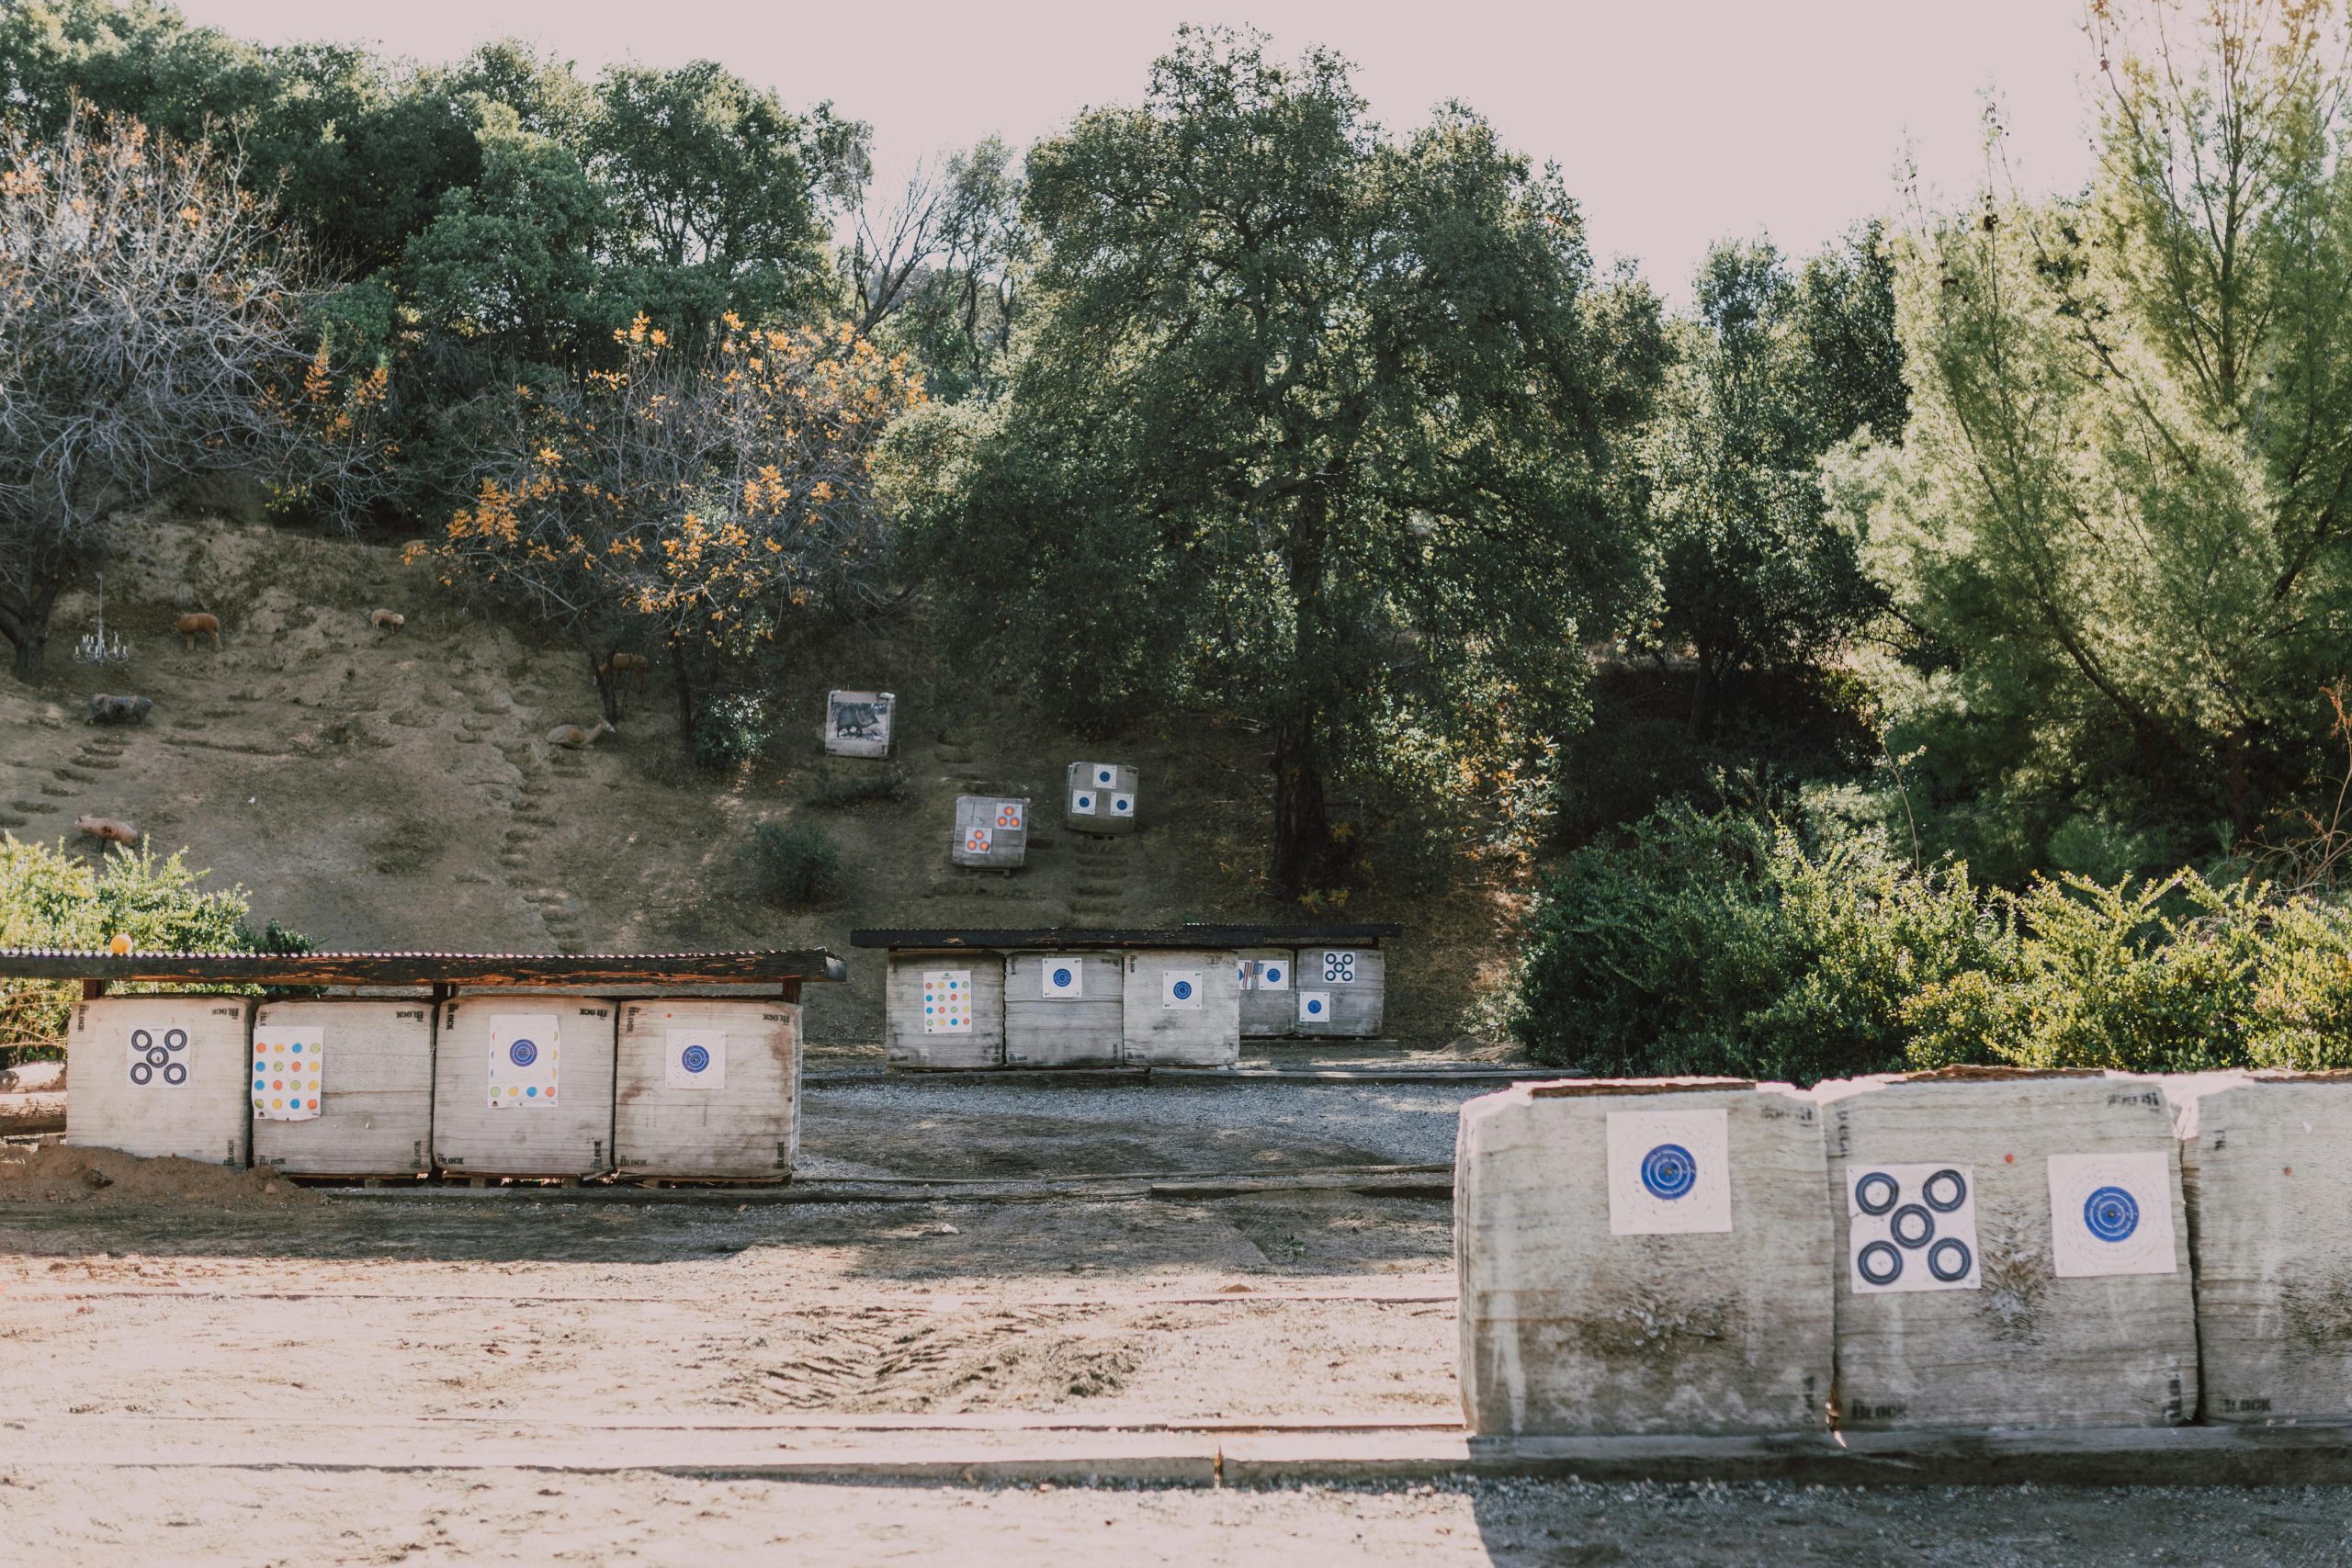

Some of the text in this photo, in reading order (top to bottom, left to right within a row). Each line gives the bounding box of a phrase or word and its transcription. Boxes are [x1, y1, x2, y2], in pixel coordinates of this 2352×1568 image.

[211, 1008, 239, 1017] BLOCK
[396, 1010, 424, 1019] BLOCK
[447, 1003, 457, 1030] BLOCK
[579, 1008, 607, 1017] BLOCK
[77, 1004, 87, 1032] BLOCK
[627, 1007, 637, 1032] BLOCK
[763, 1014, 790, 1023] BLOCK
[227, 1139, 235, 1167] BLOCK
[437, 1156, 464, 1165] BLOCK
[620, 1158, 647, 1167] BLOCK
